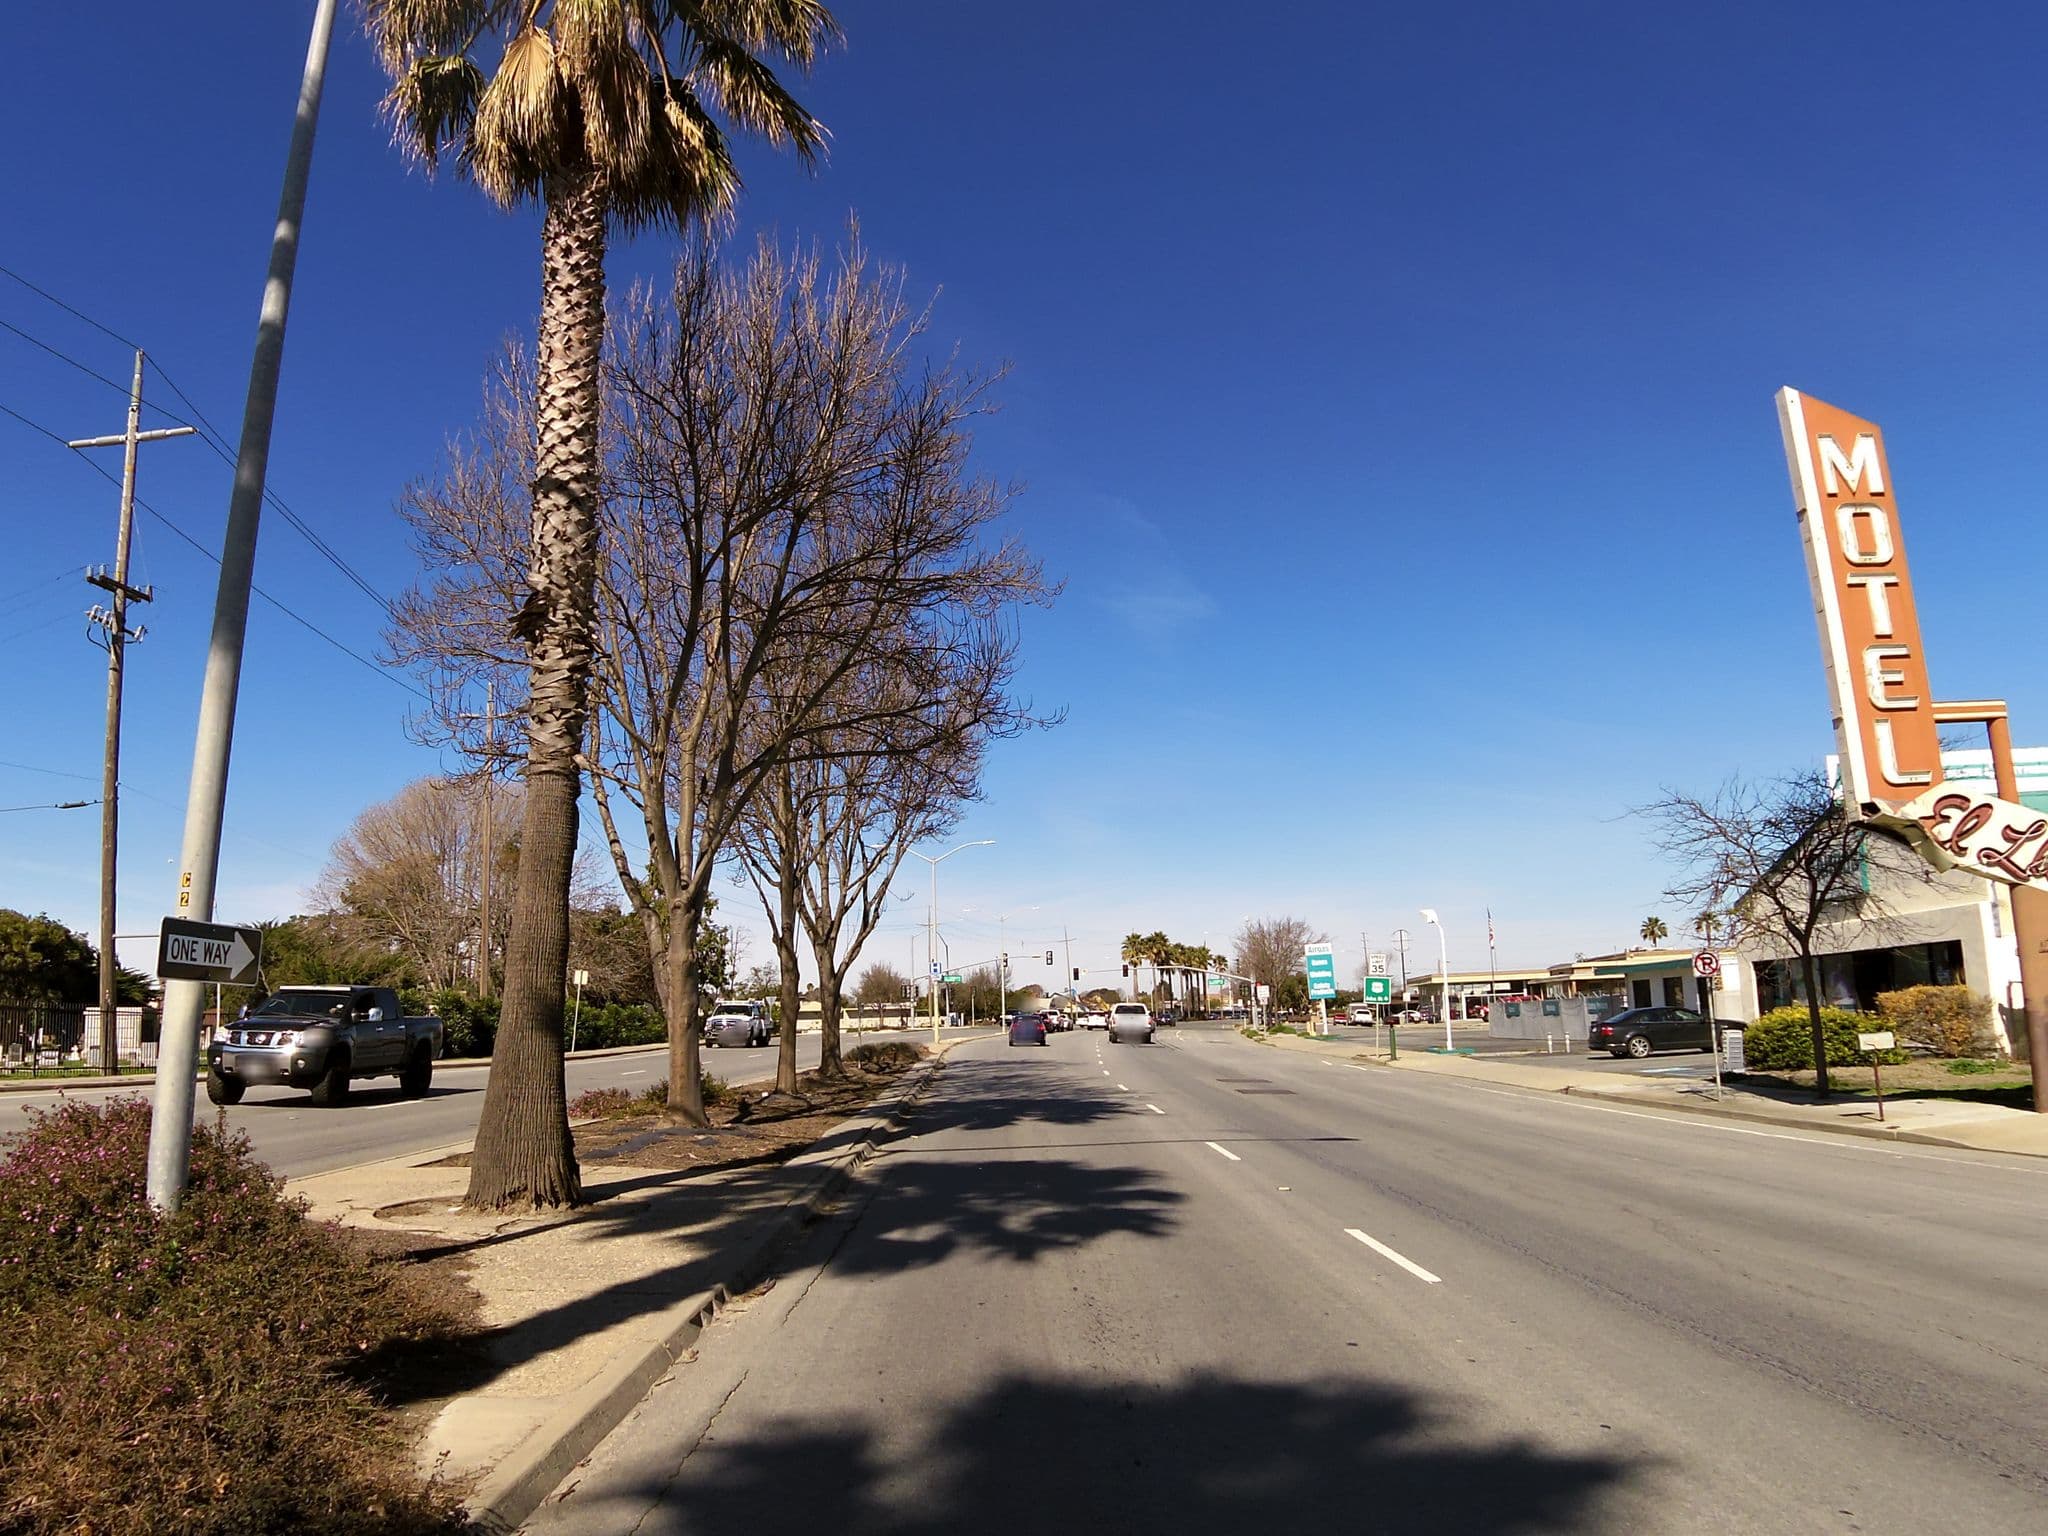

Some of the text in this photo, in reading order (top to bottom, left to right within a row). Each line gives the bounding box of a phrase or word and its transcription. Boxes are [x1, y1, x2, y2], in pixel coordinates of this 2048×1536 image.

[1816, 432, 1931, 785] MOTEL
[1919, 793, 1994, 858] El
[171, 937, 232, 965] ONE WAY
[1371, 964, 1385, 974] 35
